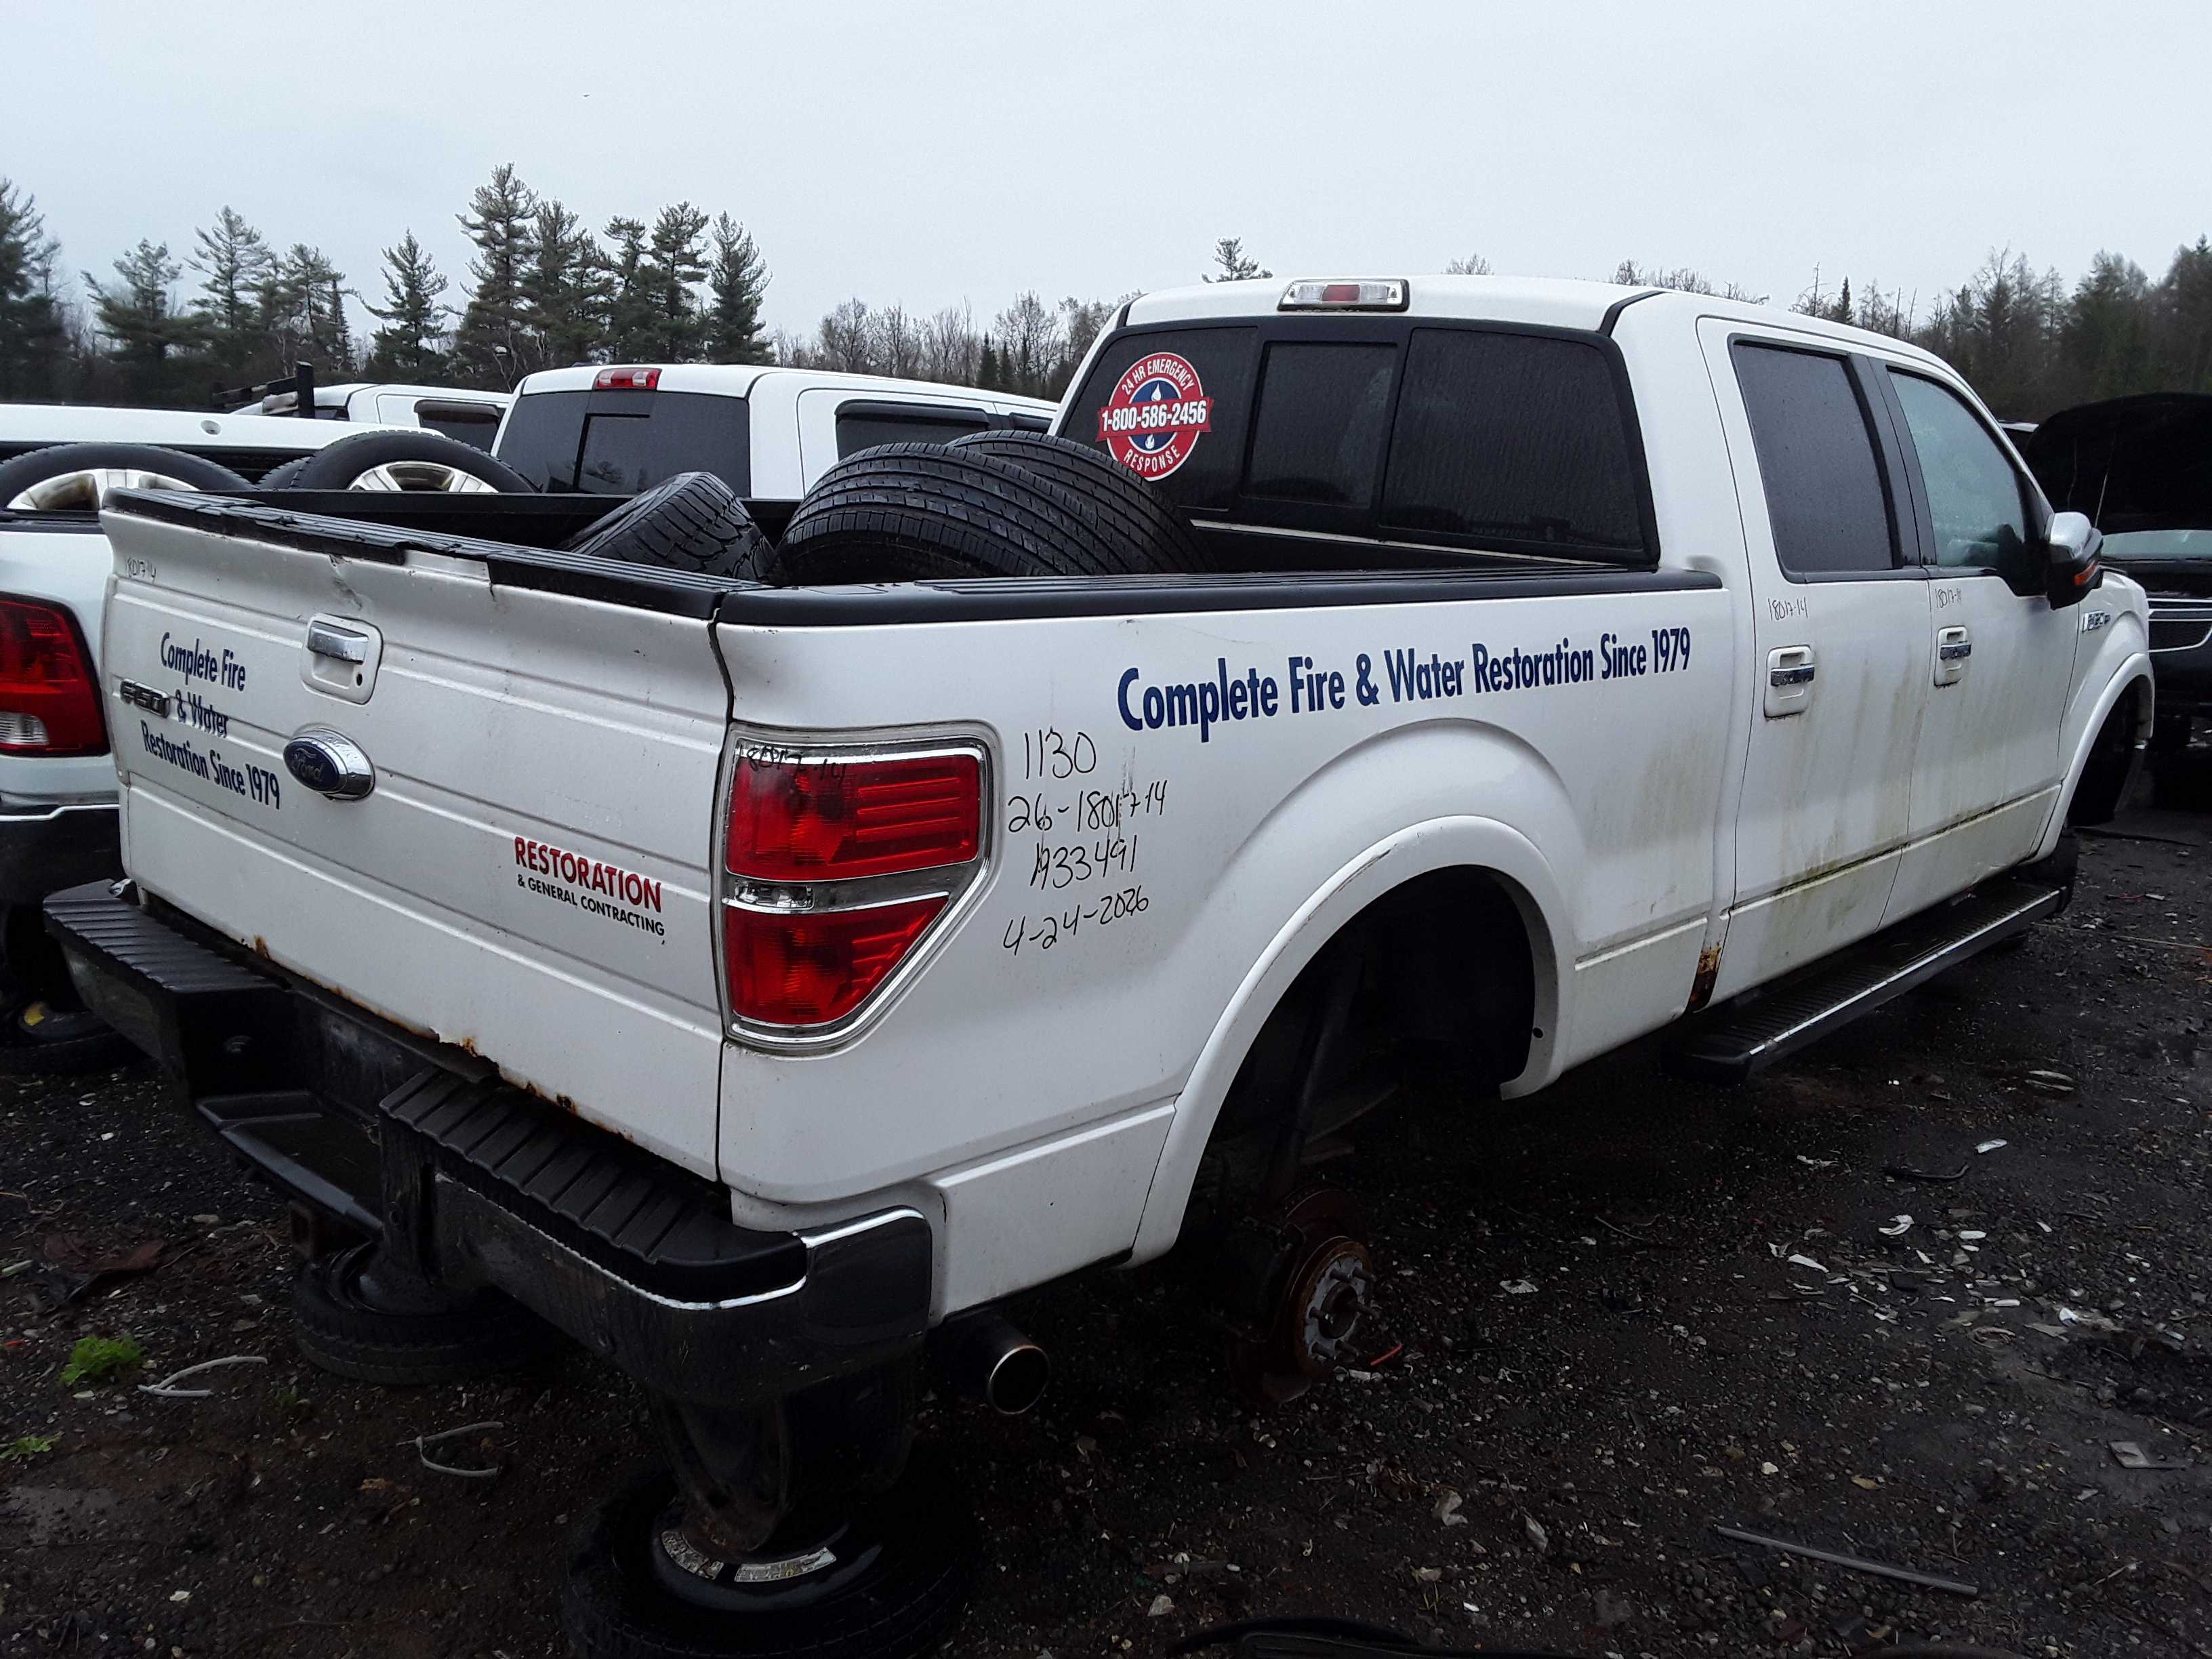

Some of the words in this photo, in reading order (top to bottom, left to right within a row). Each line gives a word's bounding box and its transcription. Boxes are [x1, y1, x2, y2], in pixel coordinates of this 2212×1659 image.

[1122, 378, 1135, 395] 24
[1132, 365, 1147, 384] HR
[1147, 359, 1195, 391] EMERGENCY
[1102, 400, 1207, 432] 1-800-586-2456
[1124, 445, 1181, 472] RESPONSE
[160, 631, 218, 685] Complete
[222, 649, 246, 691] Fire
[1118, 657, 1279, 743] Complete
[1288, 655, 1346, 714] Fire
[1355, 653, 1380, 706] &
[1384, 648, 1465, 703] Water
[1473, 638, 1595, 693] Restoration
[1601, 633, 1647, 679] Since
[1652, 627, 1692, 673] 1979
[175, 689, 188, 723] &
[187, 694, 229, 739] Water
[140, 720, 209, 780] Restoration
[209, 750, 246, 796] Since
[246, 764, 281, 810] 1979
[1025, 726, 1096, 779] 1130
[514, 836, 662, 913] RESTORATION
[517, 874, 526, 888] &
[528, 876, 578, 906] GENERAL
[580, 895, 665, 937] CONTRACTING
[1002, 884, 1149, 956] 4-24-2026
